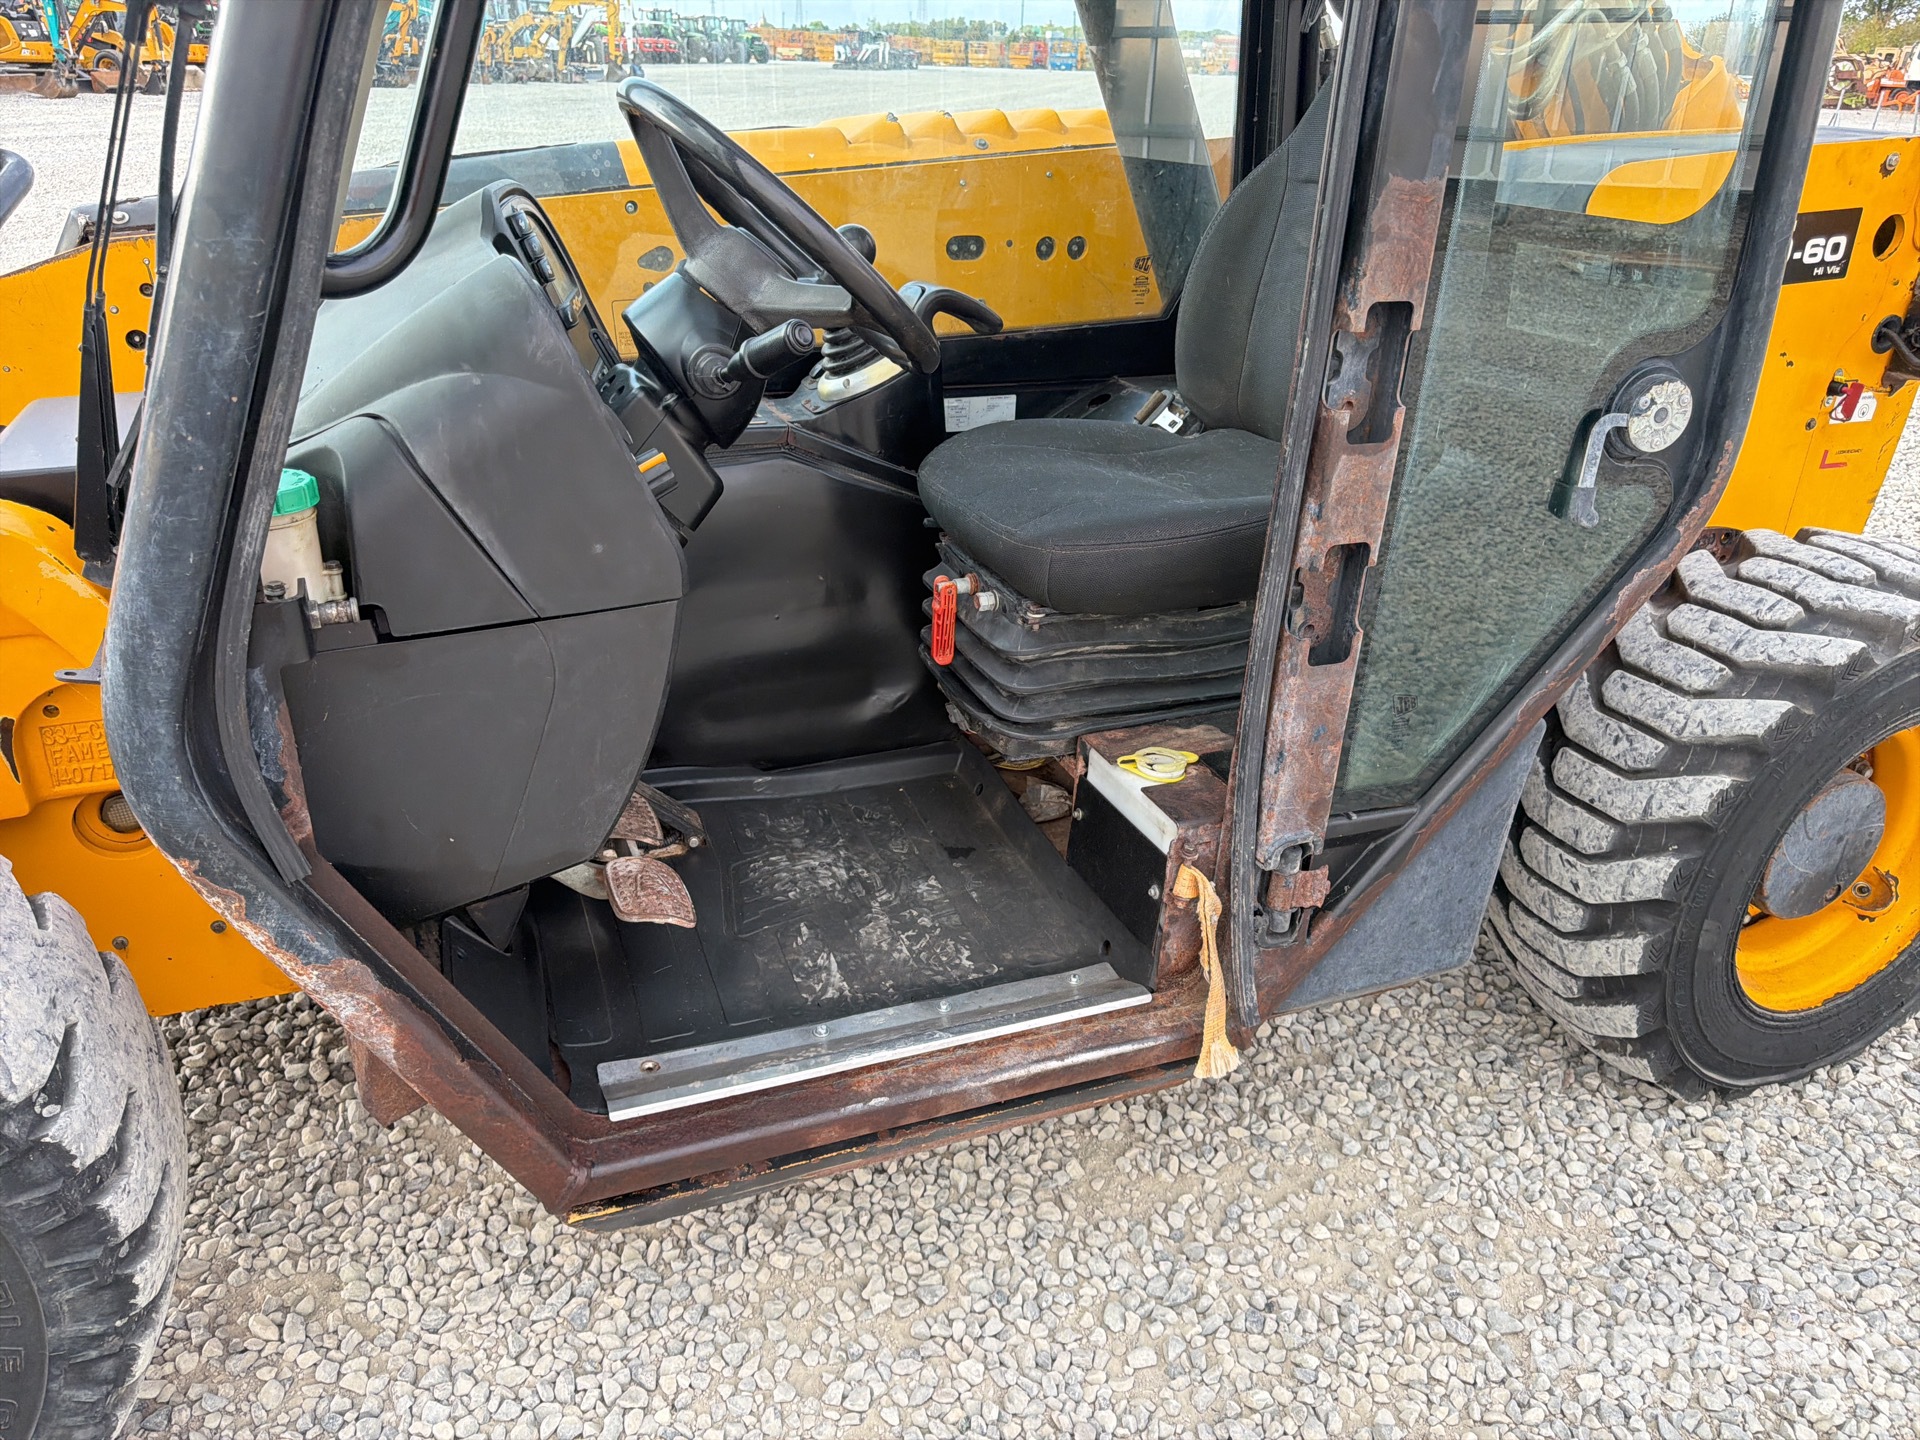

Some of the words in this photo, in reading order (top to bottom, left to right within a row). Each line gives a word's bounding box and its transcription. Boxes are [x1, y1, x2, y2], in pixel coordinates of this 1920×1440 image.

[1788, 236, 1847, 264] -60
[1813, 266, 1824, 276] Hi
[1827, 265, 1840, 275] Viz
